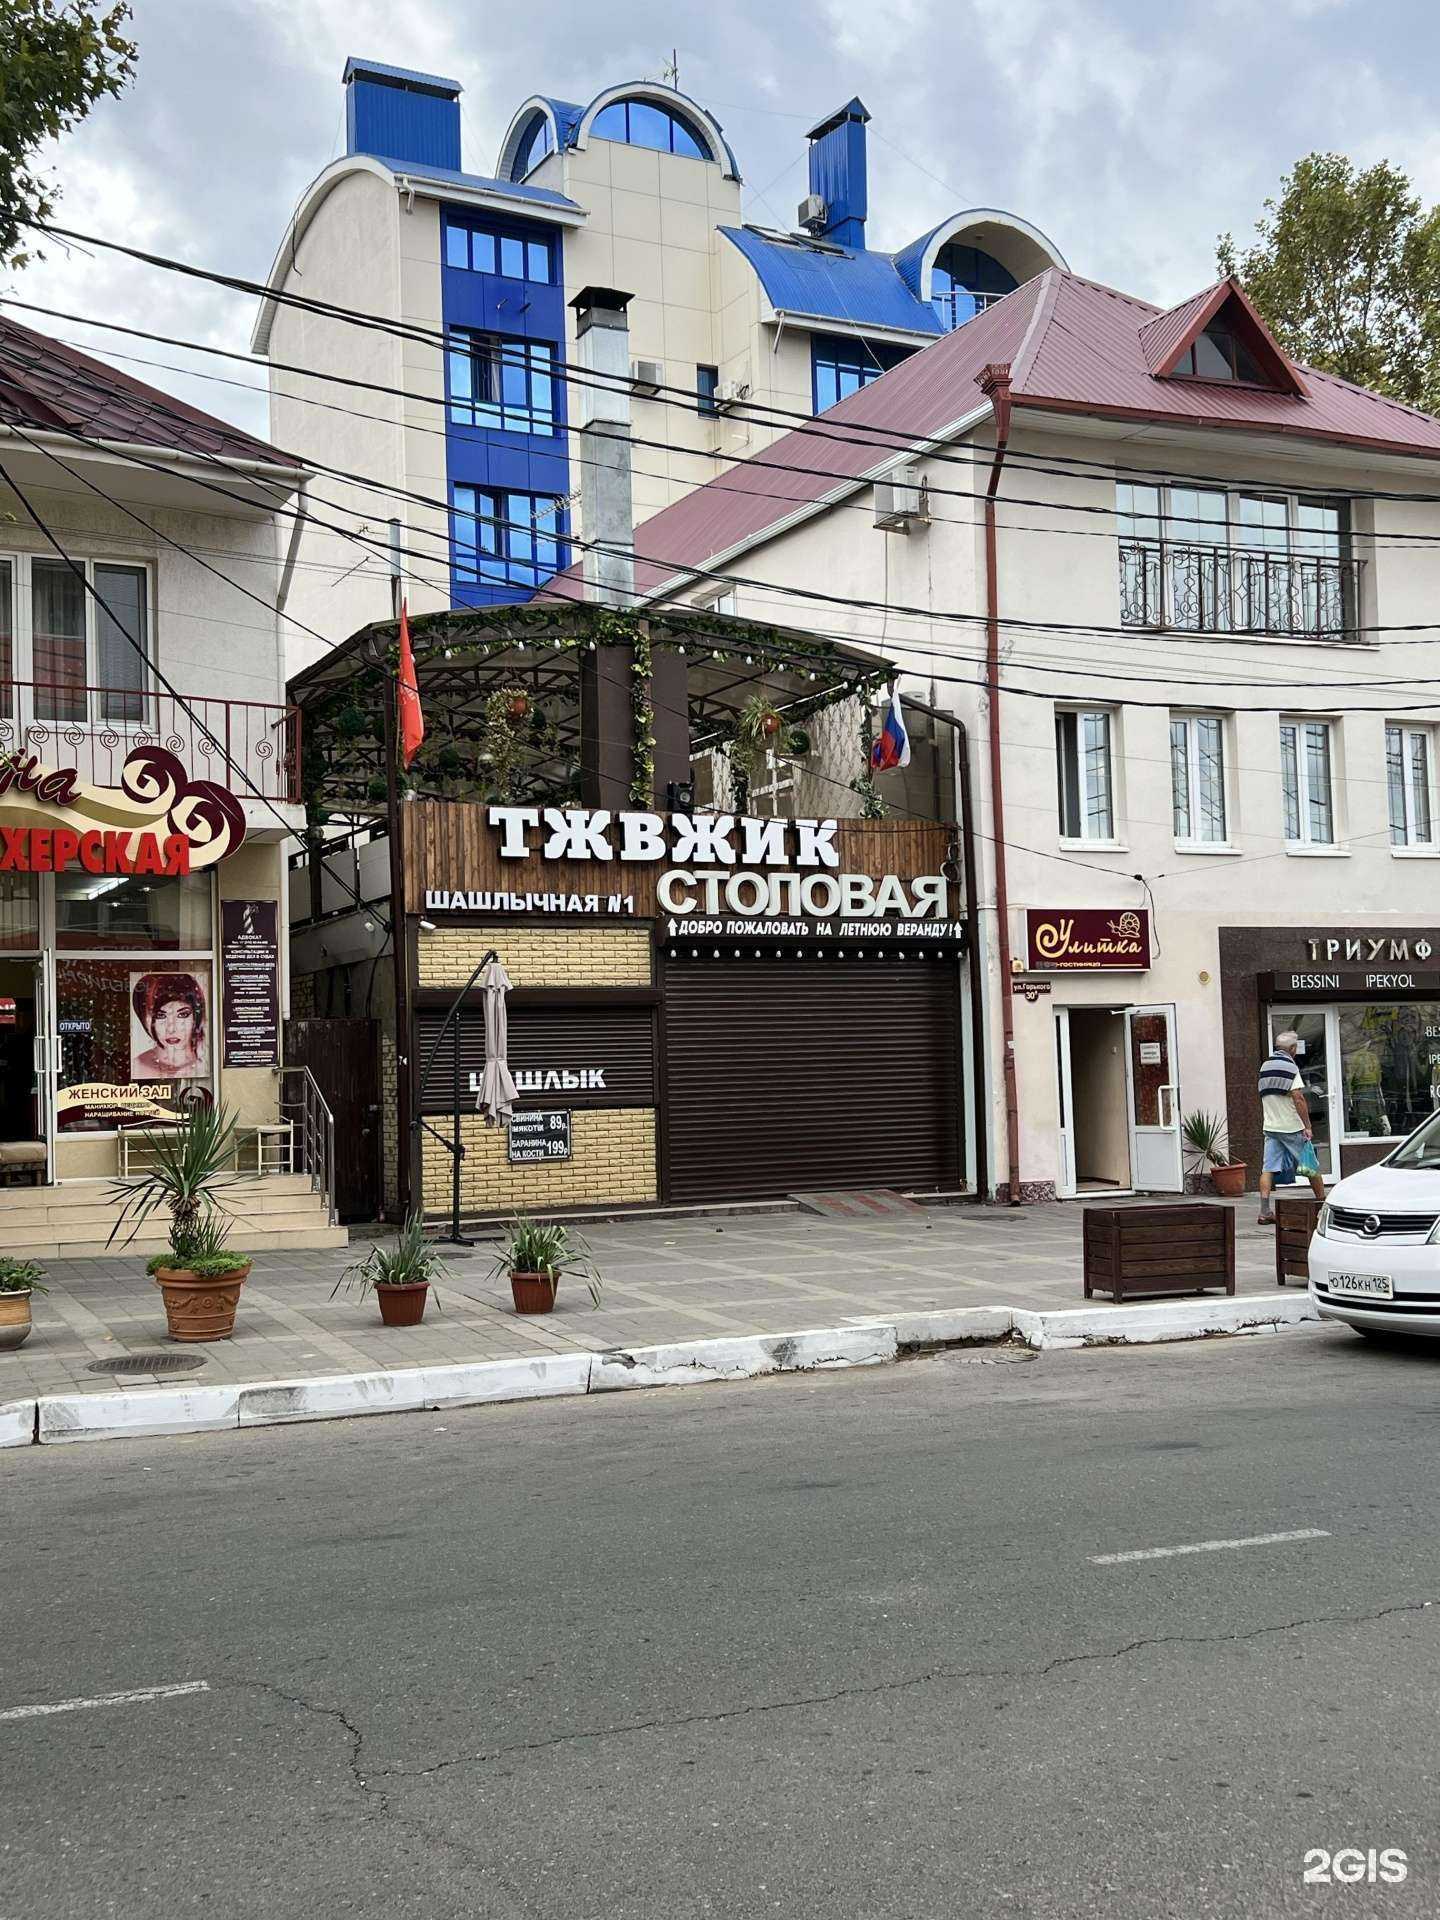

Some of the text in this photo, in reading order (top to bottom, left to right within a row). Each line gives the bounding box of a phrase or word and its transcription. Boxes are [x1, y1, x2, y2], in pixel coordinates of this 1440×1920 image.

[488, 806, 840, 868] ТЖВЖИК
[0, 827, 190, 876] ХЕРСКАЯ
[425, 890, 599, 913] ШАШЛЫЧНАЯ
[656, 869, 949, 918] СТОЛОВАЯ
[678, 920, 723, 935] ДОБРО
[726, 921, 809, 936] ПОЖАЛОВАТЬ
[816, 923, 833, 936] НА
[839, 923, 892, 937] ЛЕТНЮЮ
[1035, 918, 1143, 959] Улитка
[1308, 938, 1432, 961] ТРИУМФ
[1291, 974, 1416, 988] BESSINI IPEKYOL
[59, 1022, 90, 1031] ОТКРЫТО
[1426, 1025, 1440, 1037] BE
[68, 1085, 169, 1099] ЖЕНСКИЙ ЗАЛ
[511, 1139, 546, 1148] БАРАНИНА
